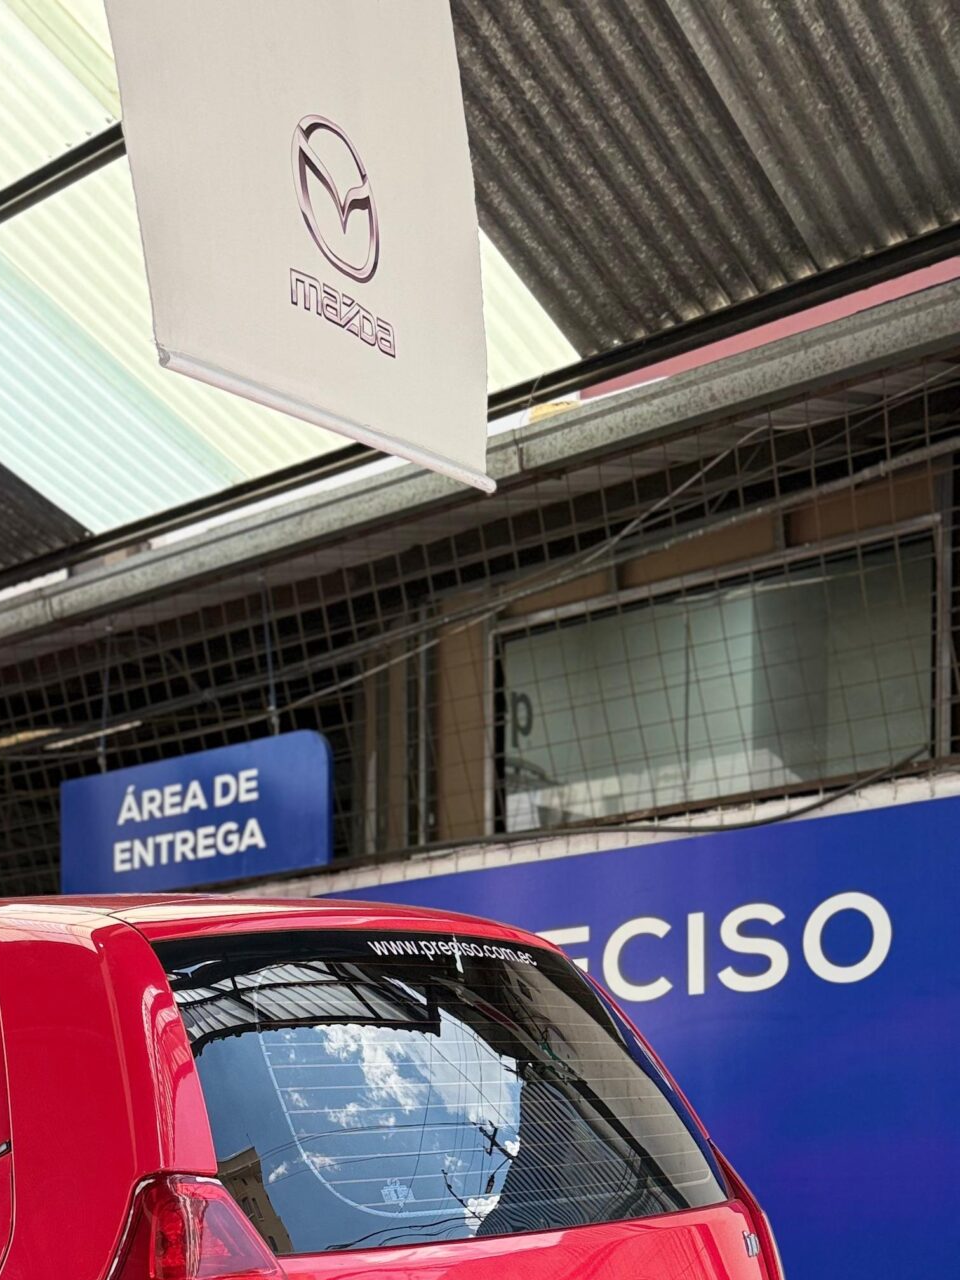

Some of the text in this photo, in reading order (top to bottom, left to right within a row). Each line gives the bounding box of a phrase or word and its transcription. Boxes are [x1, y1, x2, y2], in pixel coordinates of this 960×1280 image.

[116, 768, 259, 826] ÁREA DE
[113, 817, 267, 873] ENTREGA
[367, 939, 538, 967] www.preciso.com.ec
